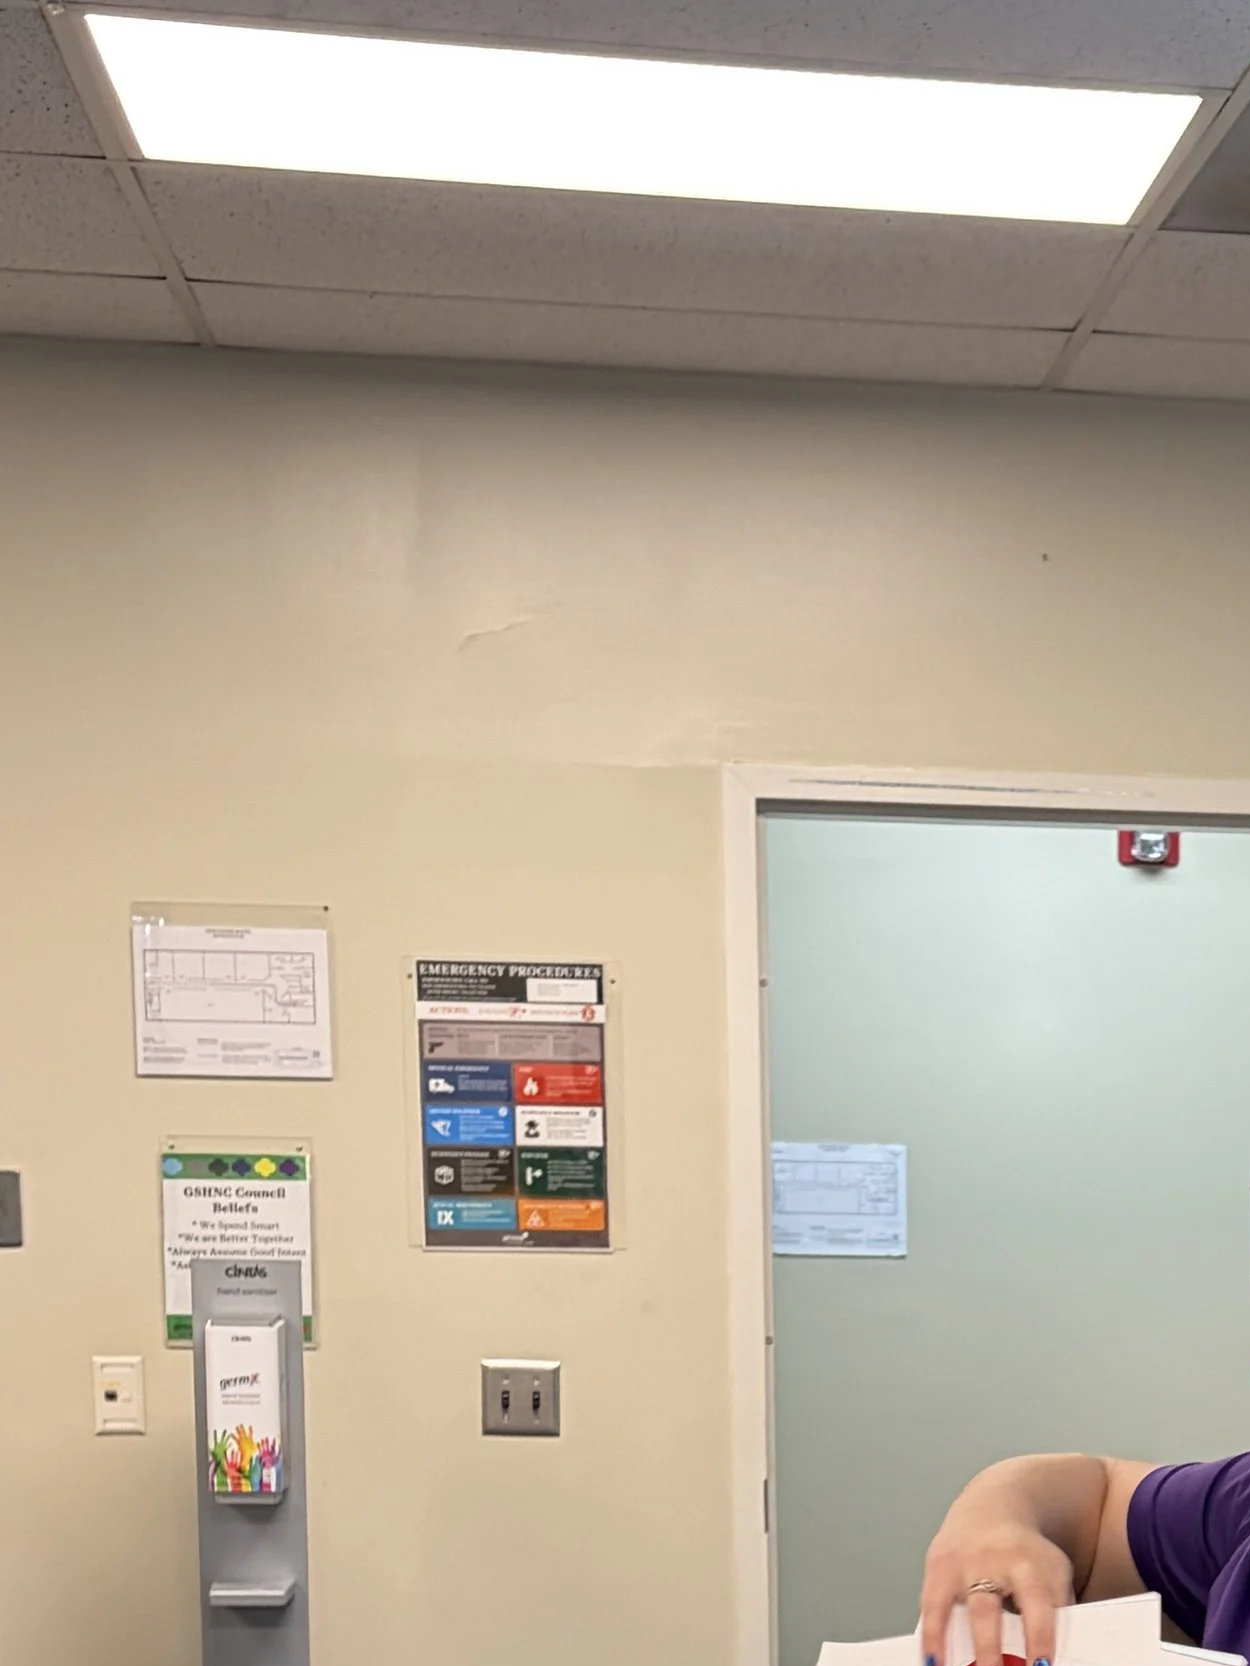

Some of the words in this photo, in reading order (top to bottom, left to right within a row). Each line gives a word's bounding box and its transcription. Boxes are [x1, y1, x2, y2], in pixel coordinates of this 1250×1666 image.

[419, 963, 506, 977] EMERGENCY
[509, 965, 602, 979] PROCEDURES
[235, 1187, 286, 1199] Council
[213, 1202, 259, 1214] Beliefs
